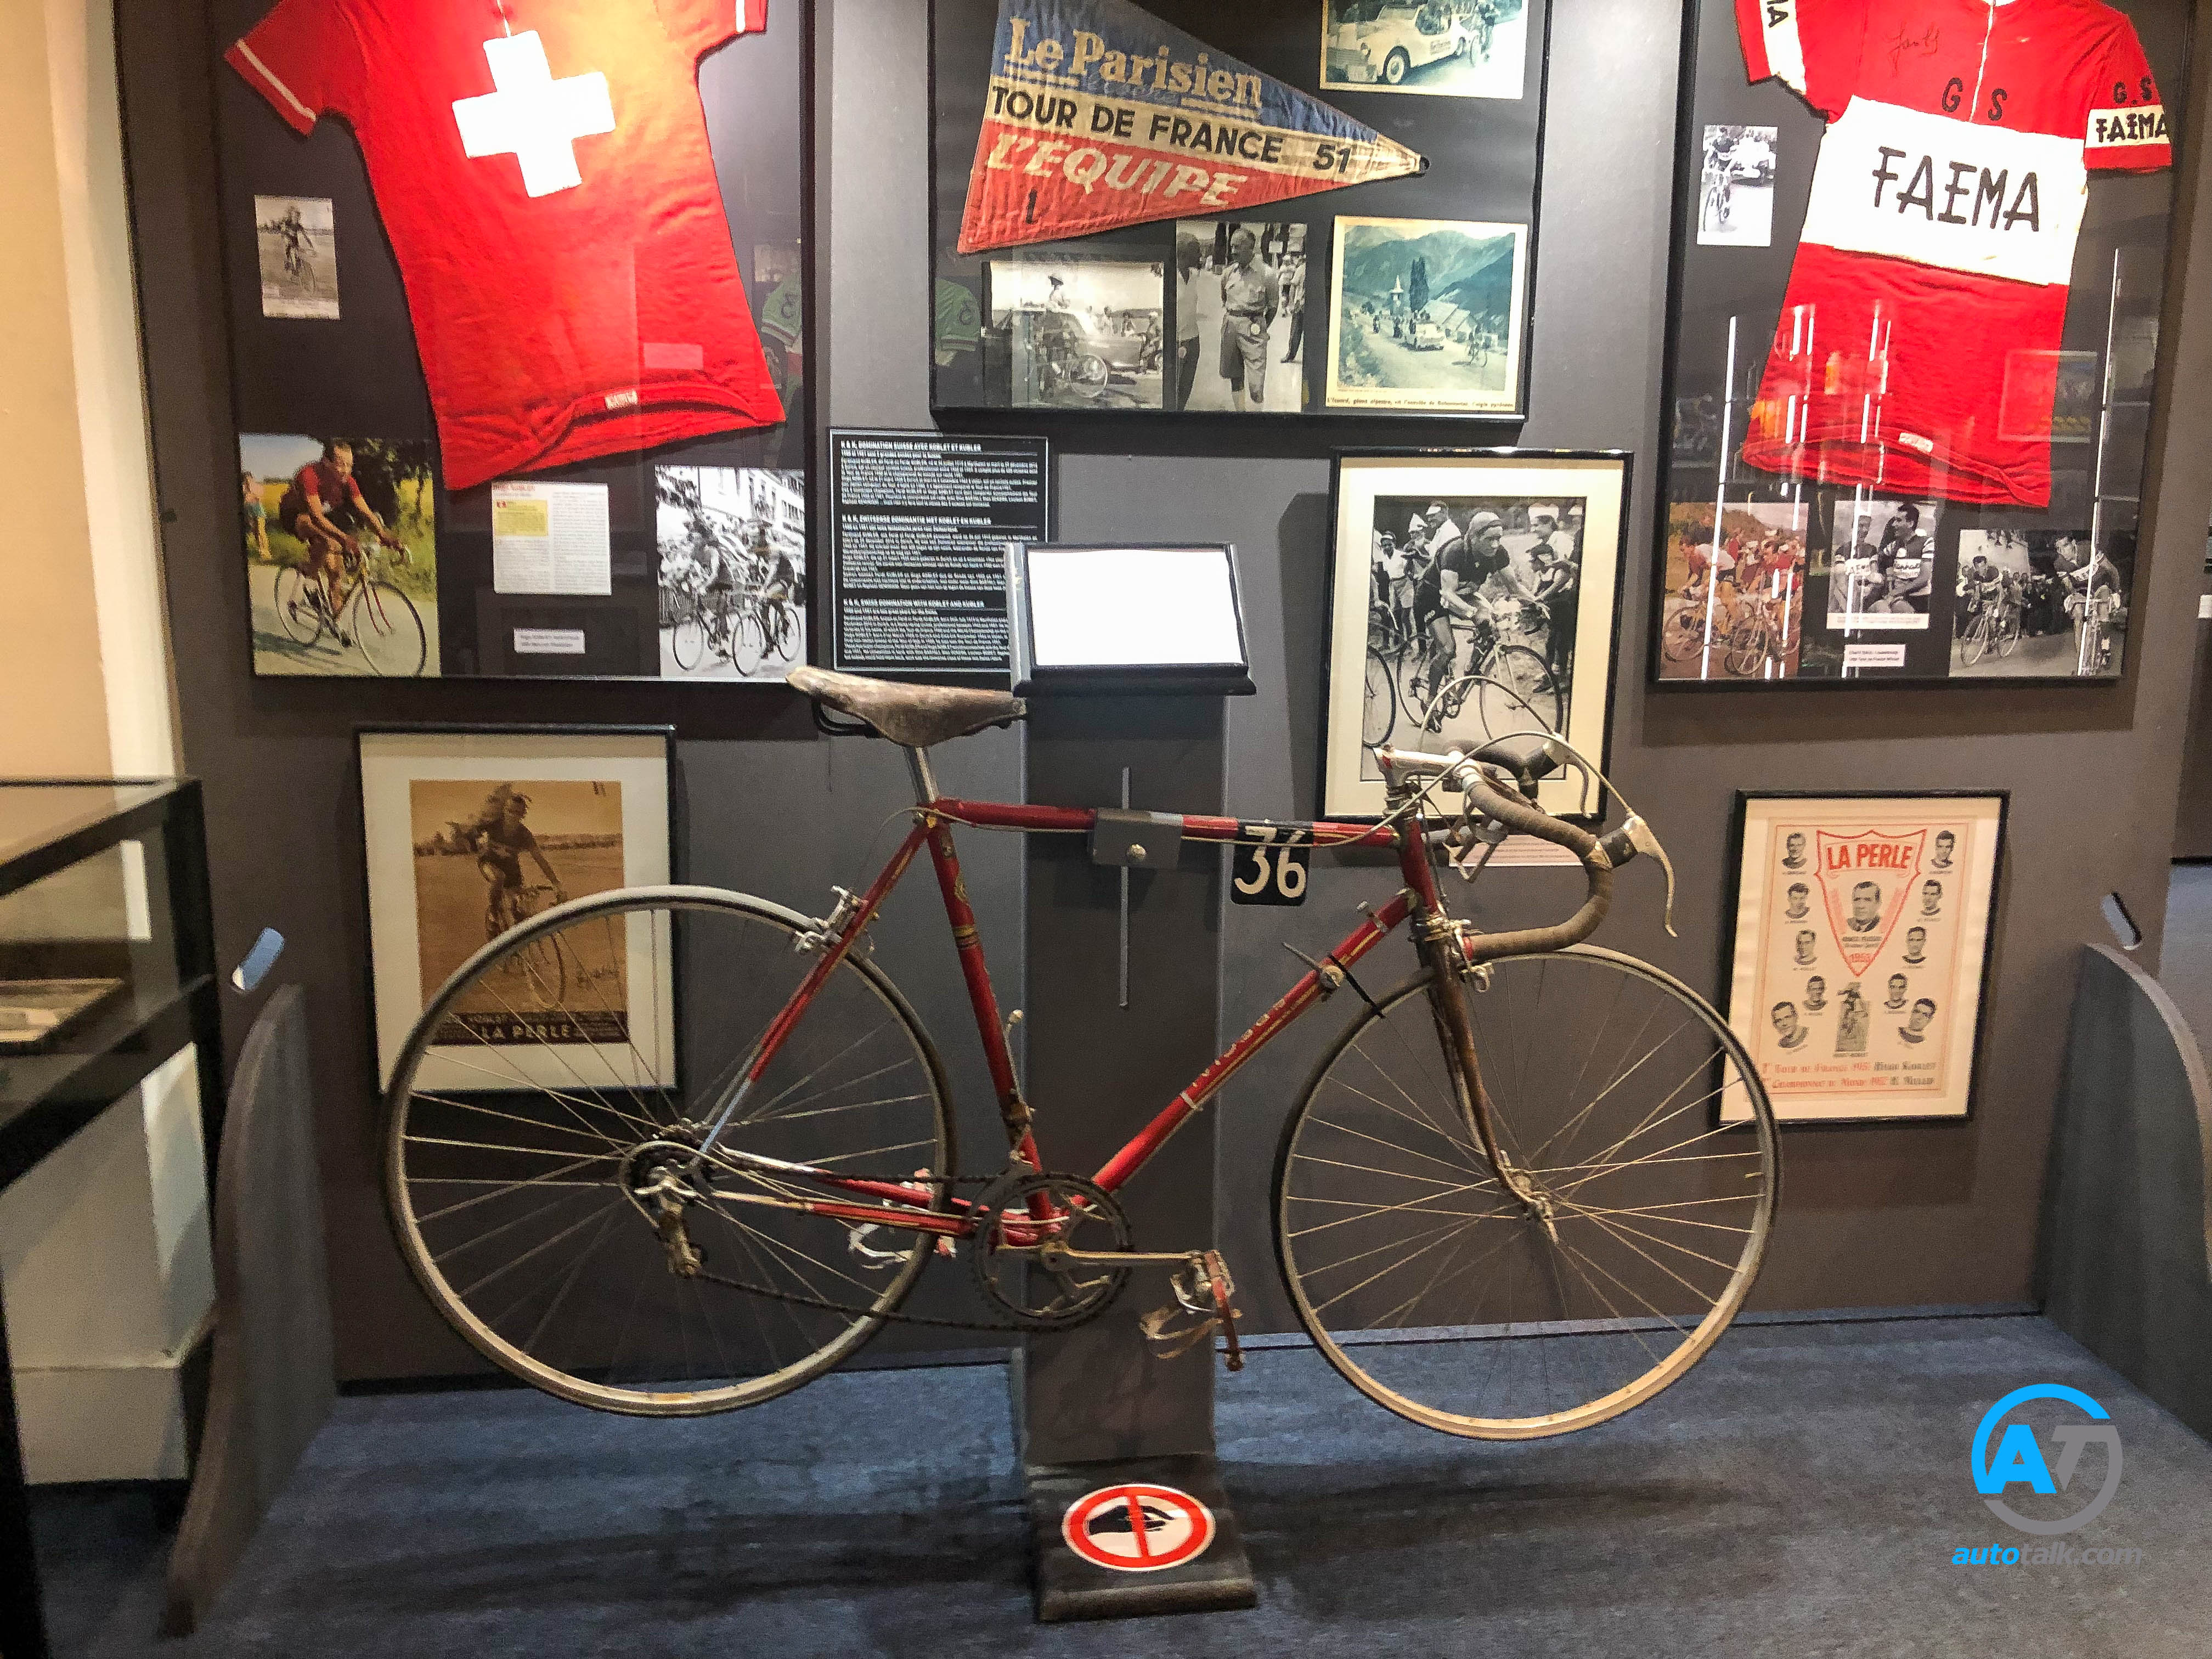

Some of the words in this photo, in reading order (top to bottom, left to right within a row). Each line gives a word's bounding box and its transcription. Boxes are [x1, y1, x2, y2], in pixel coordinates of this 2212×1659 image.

[1004, 16, 1064, 70] Le
[1072, 28, 1263, 108] Parisien
[1941, 77, 1964, 112] G
[1987, 88, 2008, 121] S
[992, 86, 1078, 128] TOUR
[1091, 103, 1133, 137] DE
[1148, 114, 1283, 163] FRANCE
[1313, 144, 1352, 174] 51
[1872, 146, 2040, 232] FAEMA
[1234, 826, 1307, 898] 36
[1827, 845, 1851, 870] LA
[1857, 844, 1912, 869] PERLE
